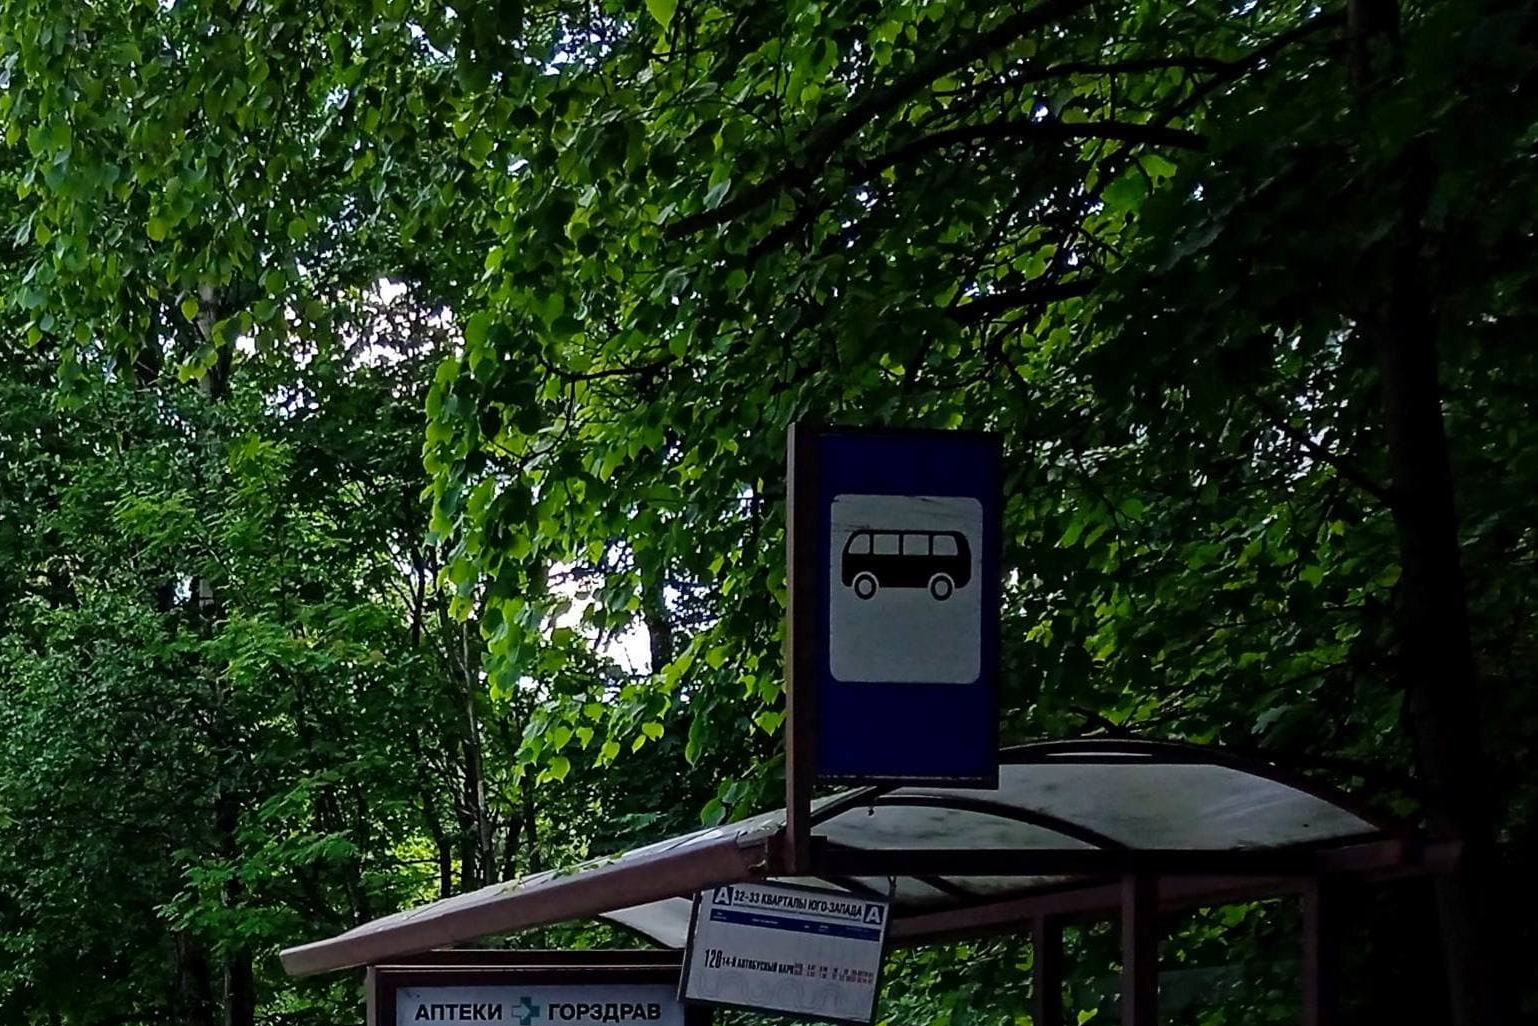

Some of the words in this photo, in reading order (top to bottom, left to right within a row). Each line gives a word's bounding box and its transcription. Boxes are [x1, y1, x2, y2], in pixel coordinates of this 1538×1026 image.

[734, 890, 761, 903] 32-33
[762, 893, 807, 911] КВАРТАЛЫ
[809, 899, 862, 918] ЮГО-ЗАПАДА
[705, 948, 723, 969] 120
[737, 956, 778, 973] АВТОБУСНЫЙ
[415, 1003, 503, 1022] АПТЕКИ
[548, 1002, 662, 1023] ГОРЗДРАВ
